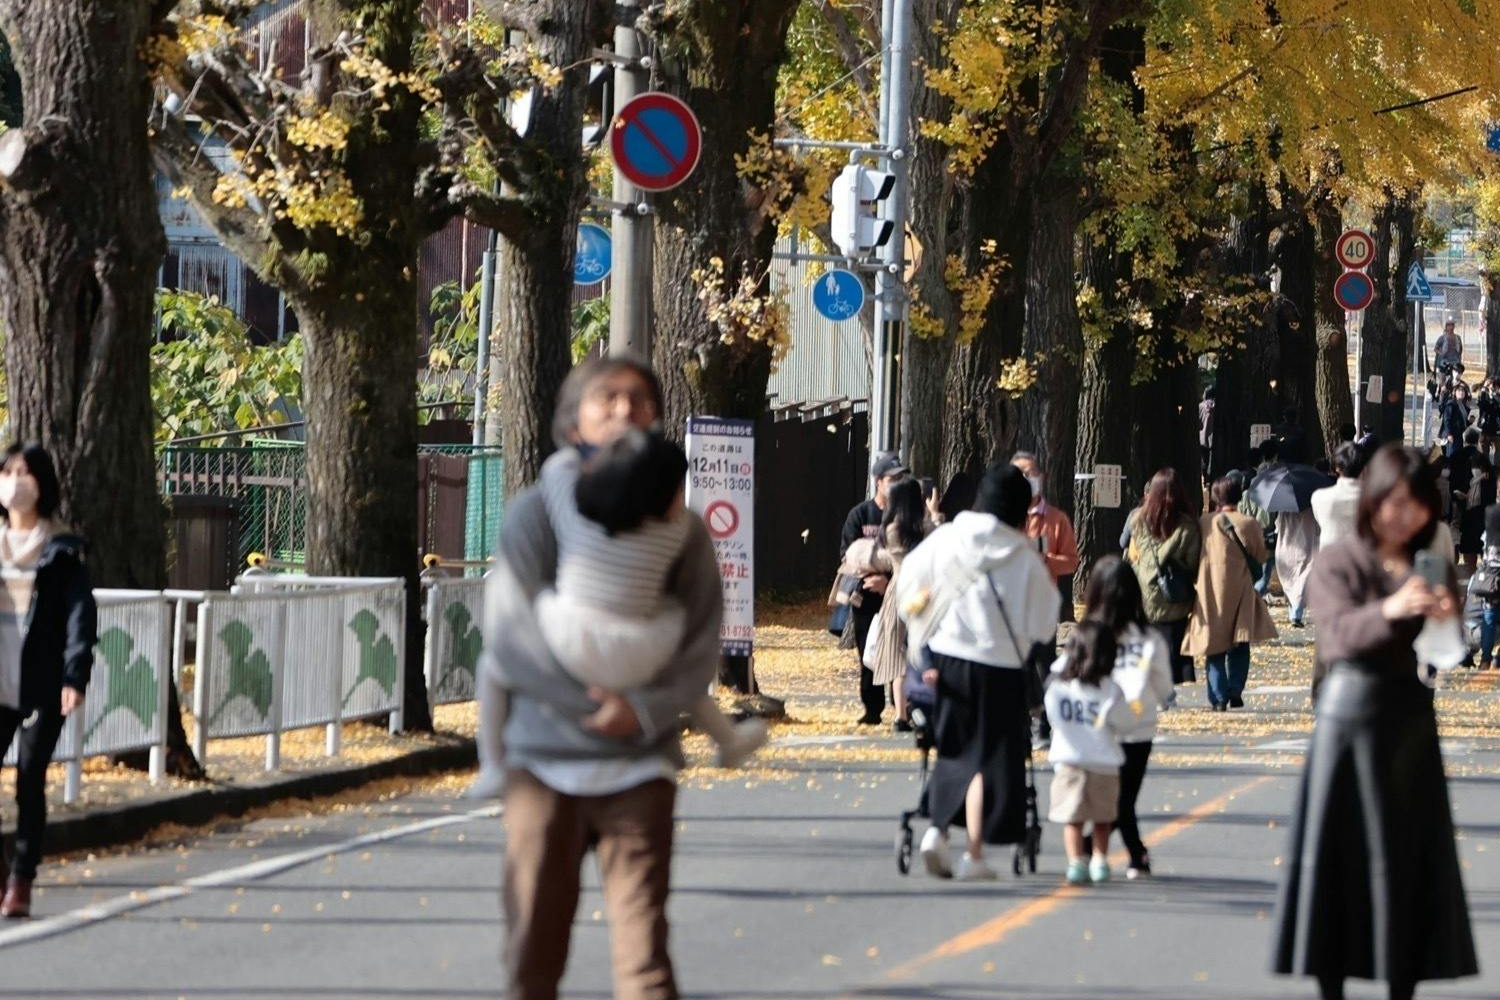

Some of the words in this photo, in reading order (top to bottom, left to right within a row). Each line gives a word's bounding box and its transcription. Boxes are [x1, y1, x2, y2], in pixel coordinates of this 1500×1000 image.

[1345, 241, 1366, 258] 40
[693, 424, 752, 436] 交通規制のお知らせ
[702, 443, 742, 454] この道路は
[718, 562, 749, 578] 禁止
